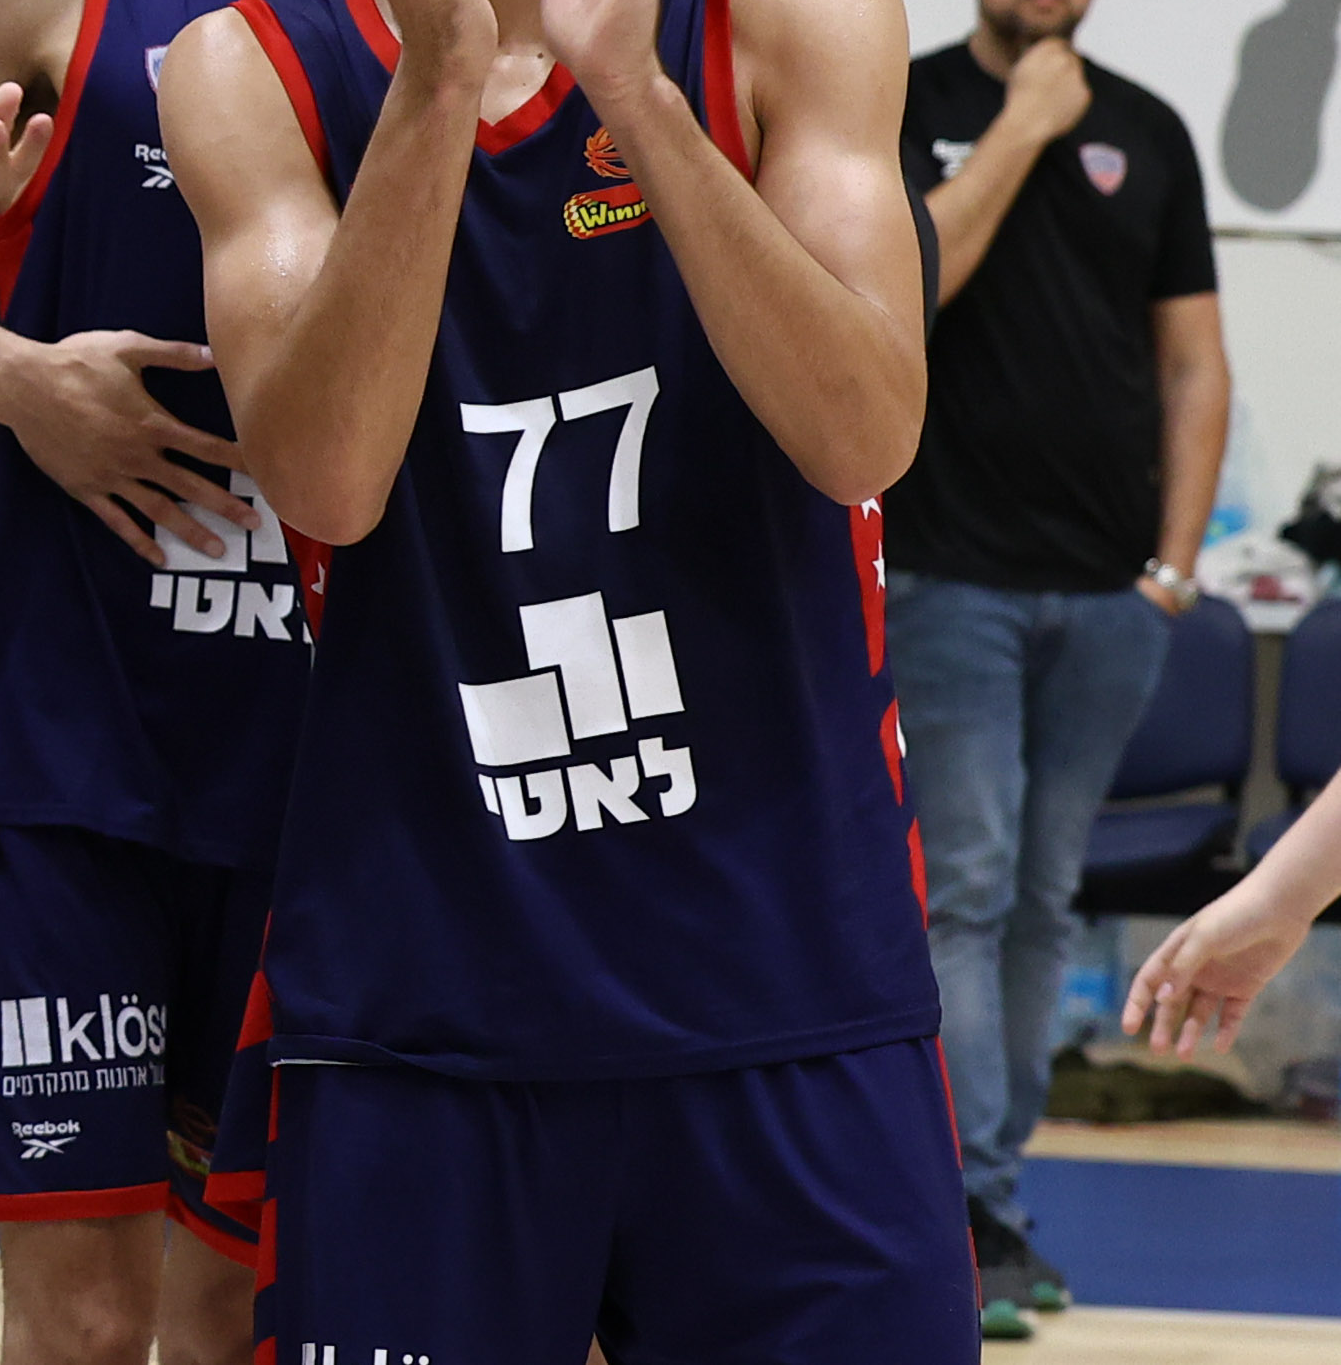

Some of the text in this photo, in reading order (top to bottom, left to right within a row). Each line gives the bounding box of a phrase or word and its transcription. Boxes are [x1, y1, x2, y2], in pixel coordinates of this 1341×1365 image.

[459, 365, 661, 554] 77
[149, 573, 308, 645] אטי
[477, 735, 698, 842] לאטי
[56, 992, 166, 1063] klös
[2, 1070, 90, 1097] מתקדמים
[95, 1065, 148, 1091] ארונות
[11, 1119, 81, 1138] Reebok
